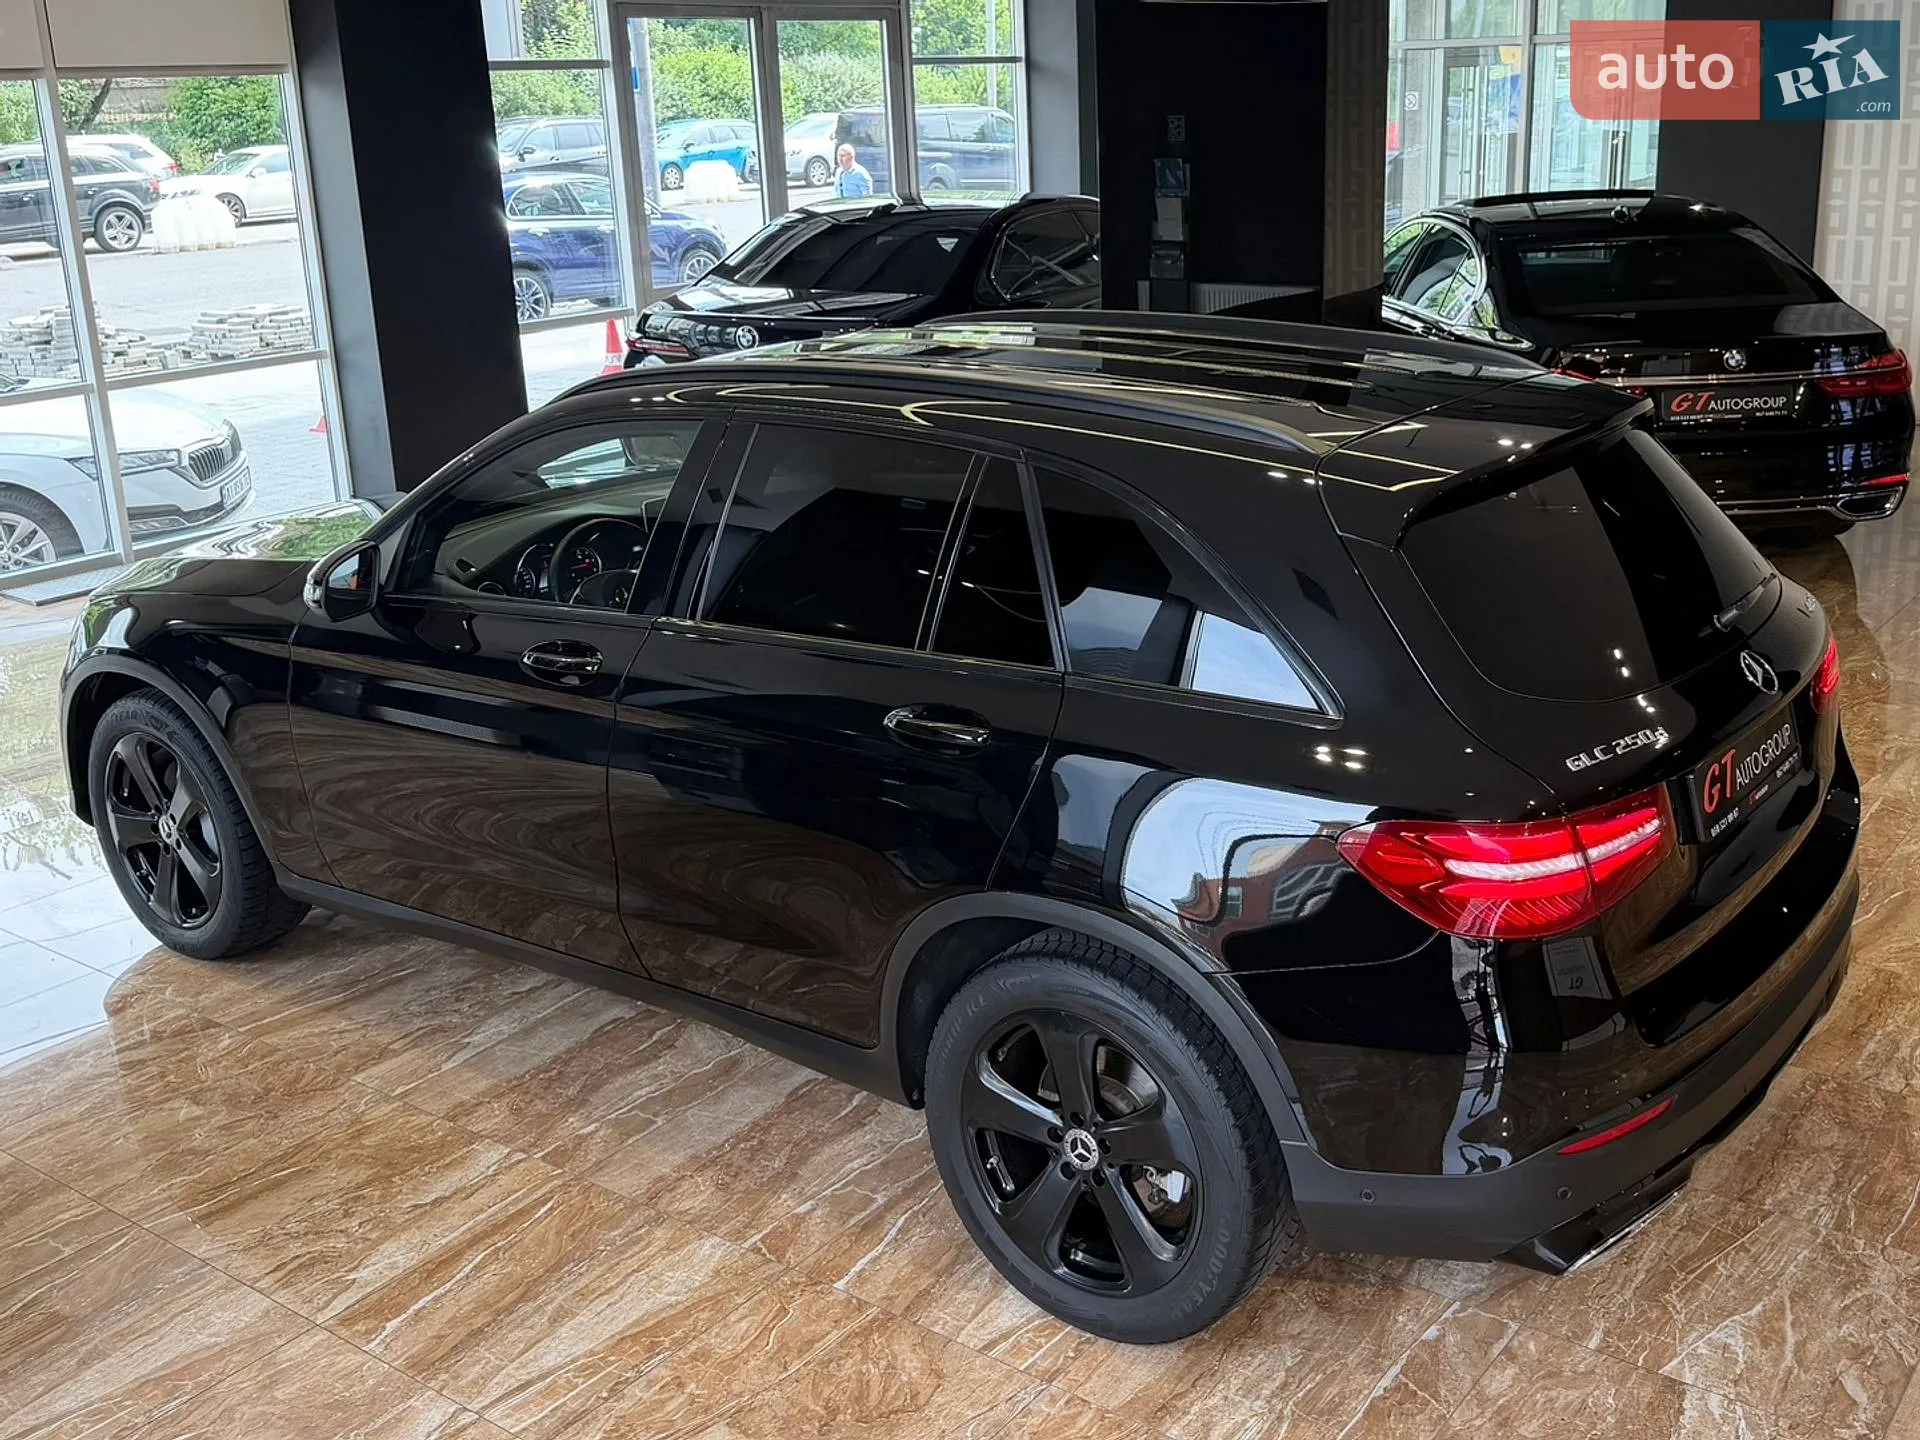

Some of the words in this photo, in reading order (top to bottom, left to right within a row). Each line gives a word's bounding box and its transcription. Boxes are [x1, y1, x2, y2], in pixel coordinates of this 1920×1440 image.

[1671, 391, 1716, 412] GT
[1708, 396, 1787, 411] AUTOGROUP
[1565, 752, 1614, 772] GLC
[1704, 749, 1736, 813] GT
[1736, 724, 1790, 790] AUTOGROUP
